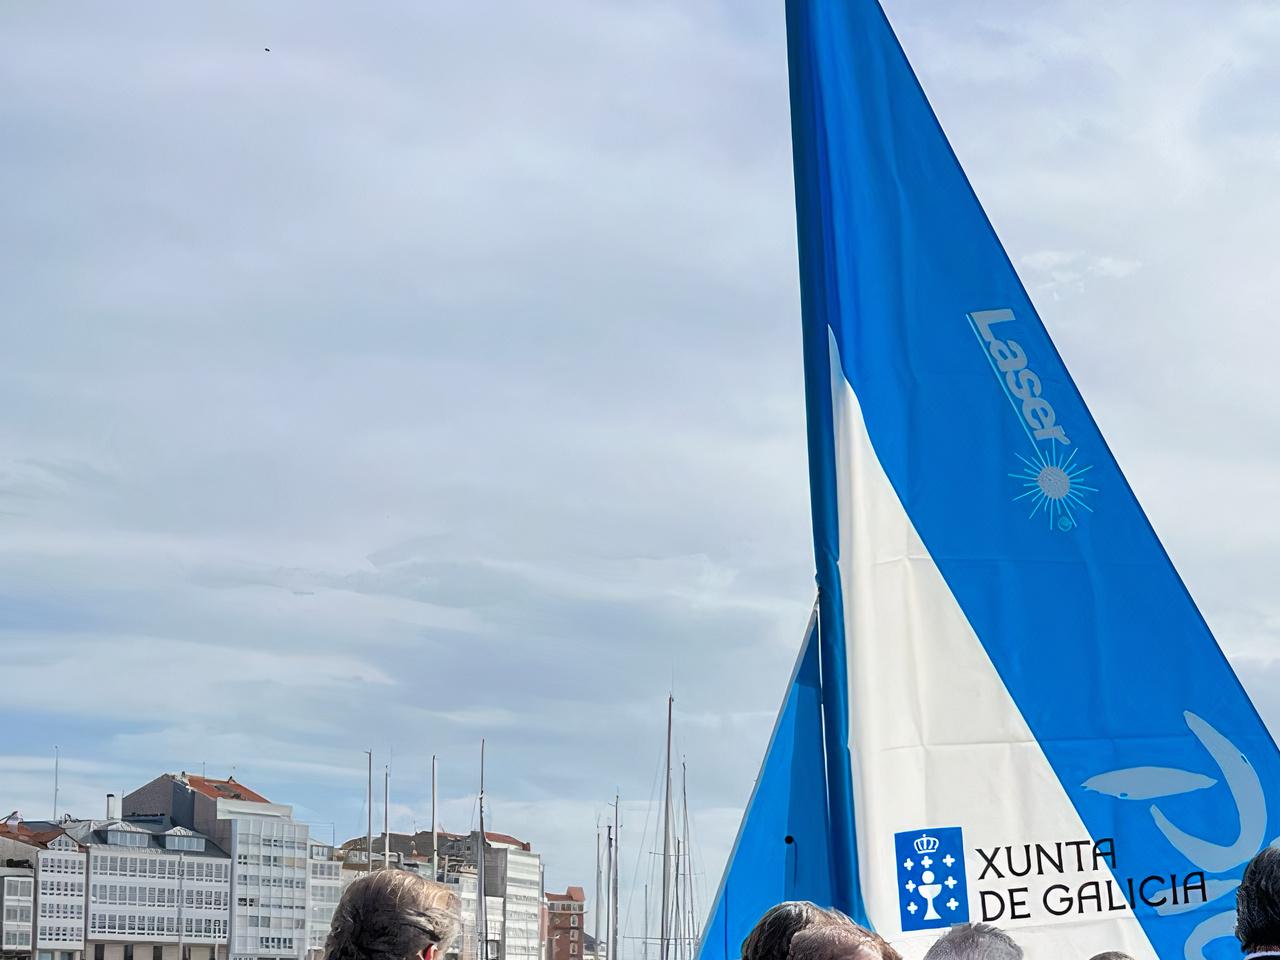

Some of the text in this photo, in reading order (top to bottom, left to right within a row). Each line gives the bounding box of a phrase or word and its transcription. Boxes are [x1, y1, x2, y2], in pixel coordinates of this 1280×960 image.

[969, 308, 1071, 445] Laser
[975, 837, 1117, 880] XUNTA
[978, 871, 1207, 922] DE GALICIA
